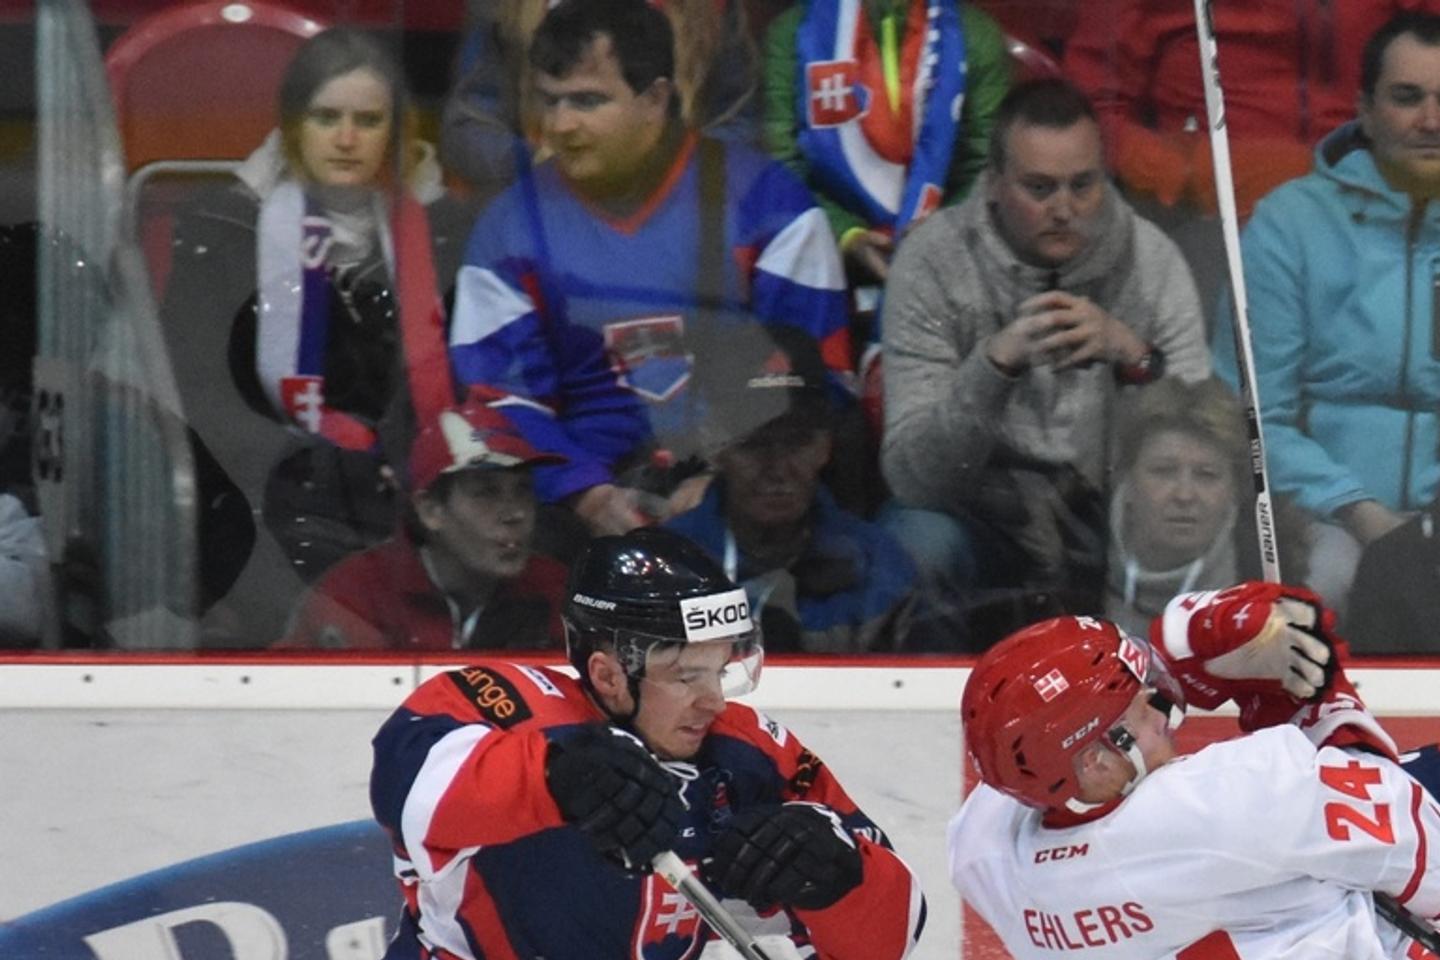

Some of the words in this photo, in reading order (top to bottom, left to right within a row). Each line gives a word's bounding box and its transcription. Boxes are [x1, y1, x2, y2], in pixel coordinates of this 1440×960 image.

[460, 668, 516, 718] ange
[1061, 716, 1100, 750] CCM
[1319, 760, 1396, 845] 24
[1034, 843, 1090, 864] CCM
[1023, 901, 1155, 951] EHLERS
